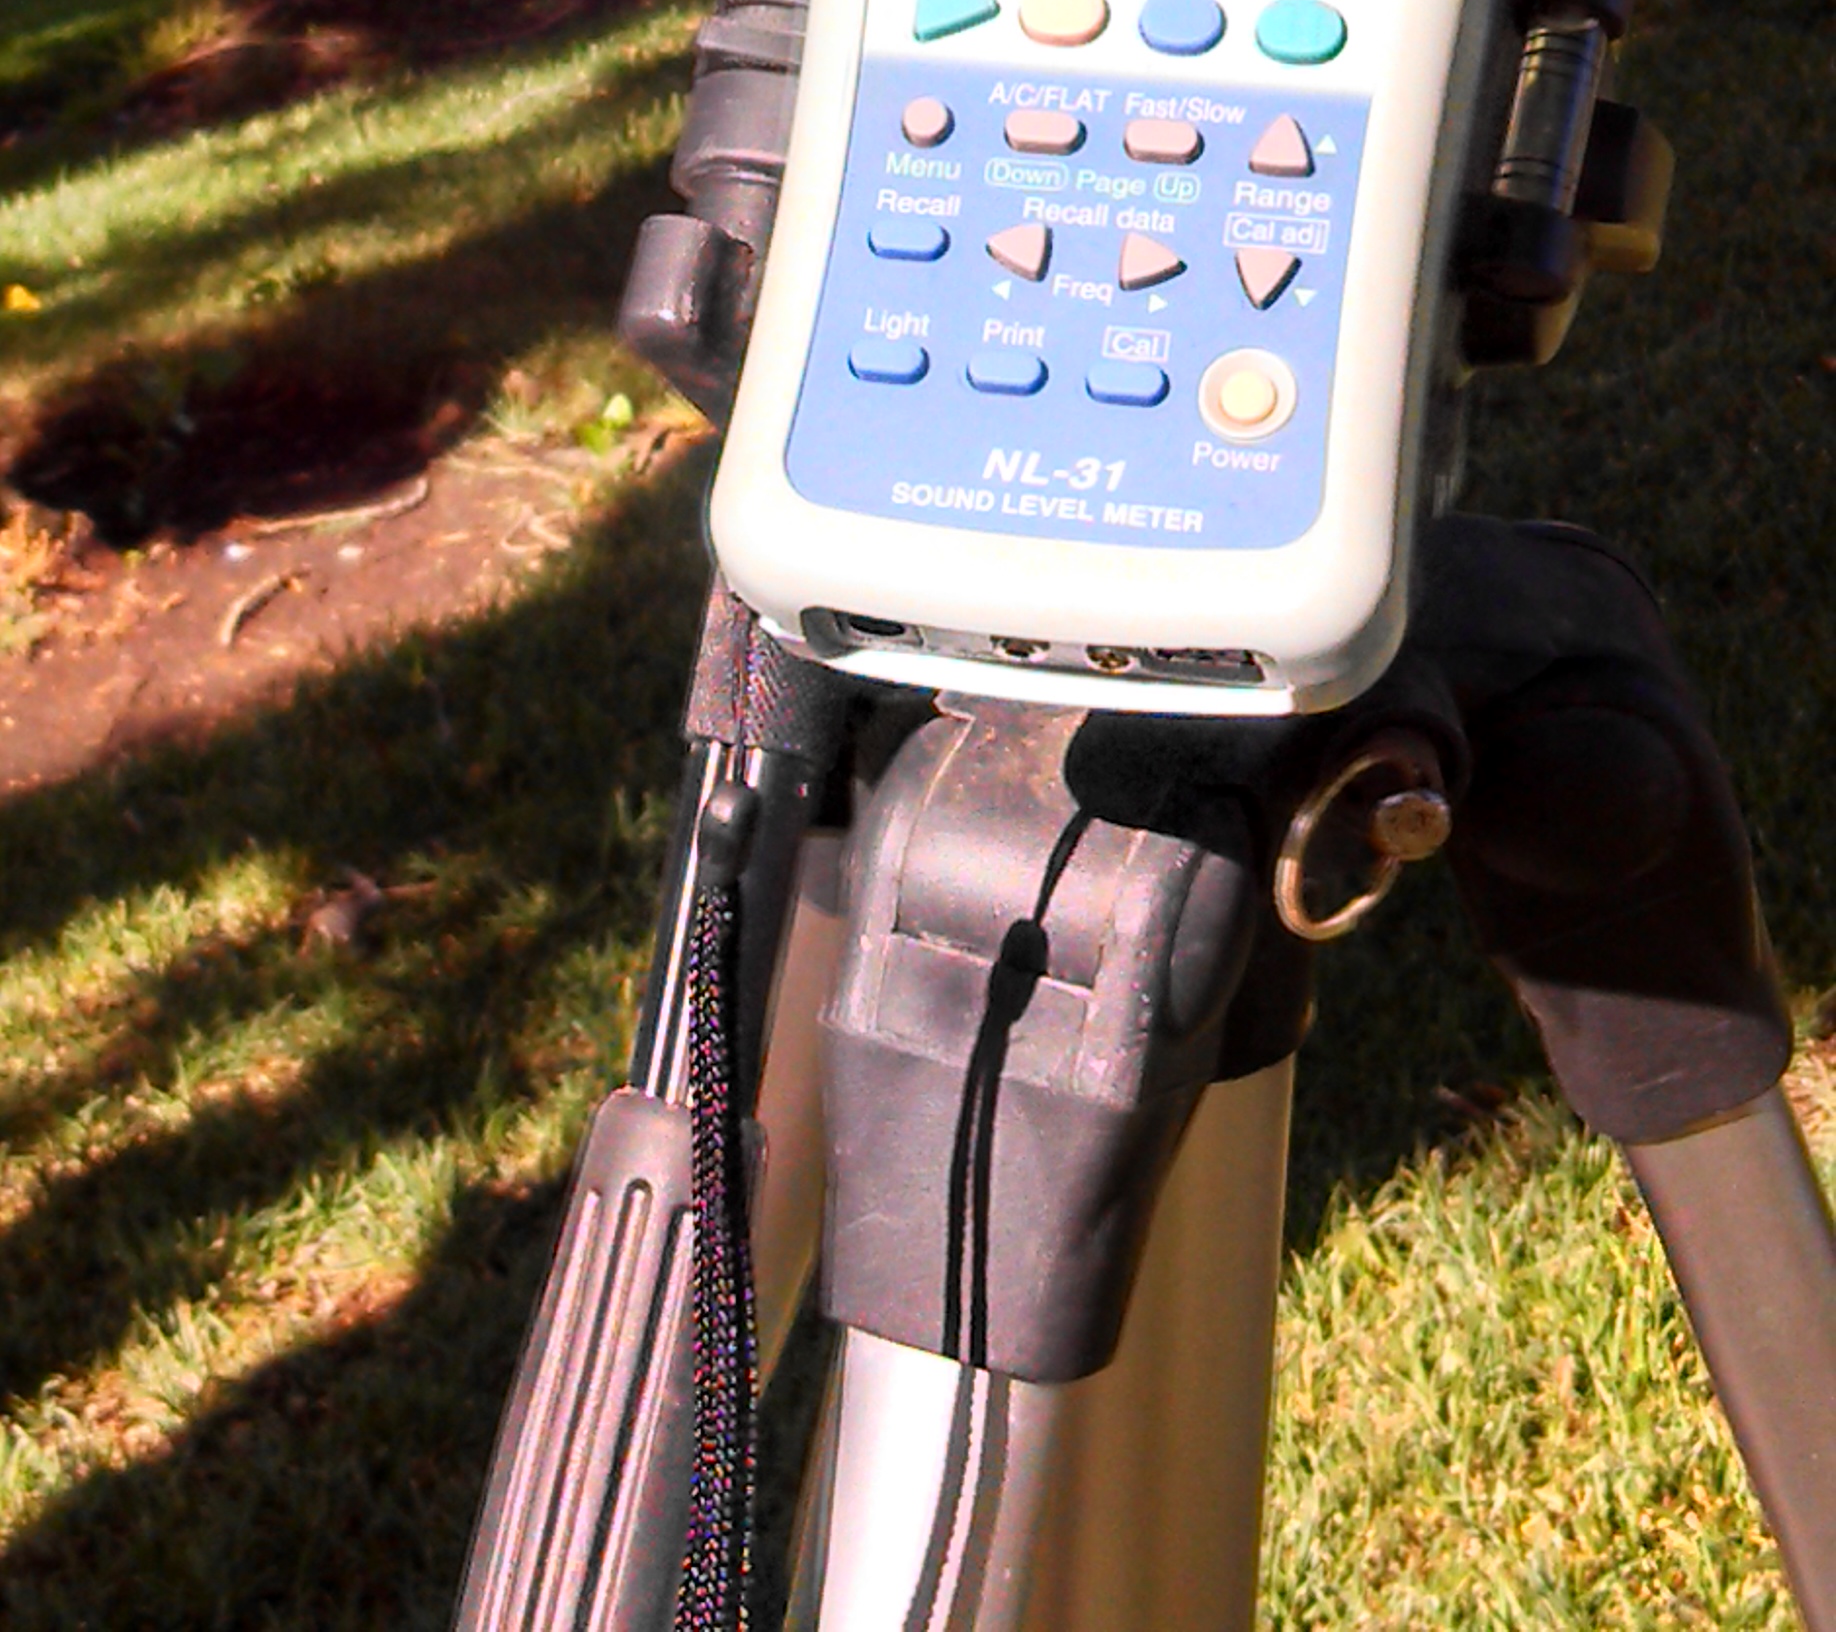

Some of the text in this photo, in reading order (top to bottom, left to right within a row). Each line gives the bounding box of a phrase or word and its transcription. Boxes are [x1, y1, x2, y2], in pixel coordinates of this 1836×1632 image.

[989, 81, 1112, 112] A/C/FLAT
[1124, 92, 1247, 123] Fast/Slow
[885, 151, 961, 180] Menu
[992, 164, 1194, 202] Down Page Up
[1232, 180, 1332, 216] Range
[876, 188, 961, 216] Recall
[1023, 197, 1175, 233] Recall data
[1232, 217, 1321, 251] Cal adj
[1053, 274, 1114, 307] Freq
[863, 308, 931, 340] Light
[983, 318, 1046, 348] Print
[1111, 333, 1160, 357] Cal
[982, 448, 1127, 492] NL-31
[1191, 441, 1282, 472] Power
[891, 481, 1205, 533] SOUND LEVEL METER
